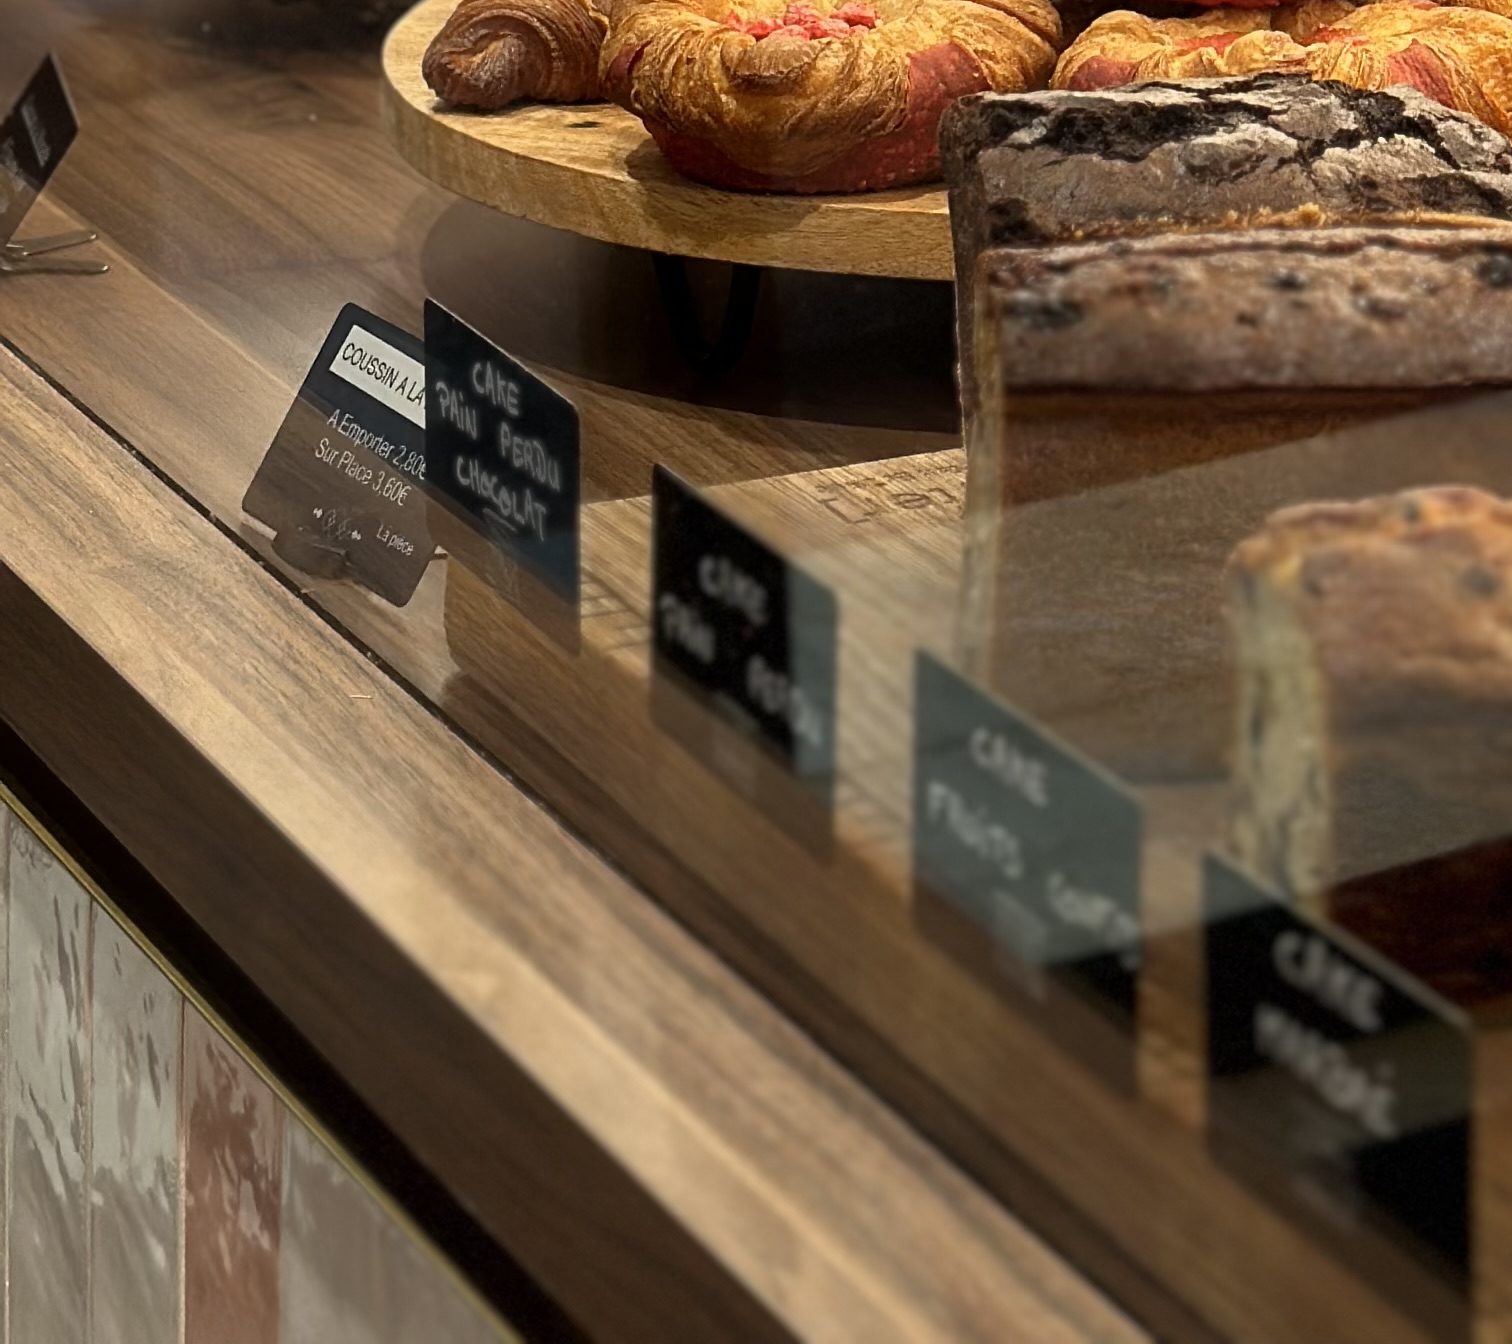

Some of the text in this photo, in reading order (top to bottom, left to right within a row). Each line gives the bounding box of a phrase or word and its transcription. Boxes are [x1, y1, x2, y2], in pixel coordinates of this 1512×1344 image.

[342, 342, 399, 389] COUSSIN
[395, 377, 409, 396] A
[472, 361, 519, 417] CAKE
[327, 409, 340, 429] A
[337, 413, 395, 460] Emporter
[499, 421, 560, 492] PERDU
[315, 437, 412, 507] Sur Place 3,60€
[376, 524, 390, 543] La
